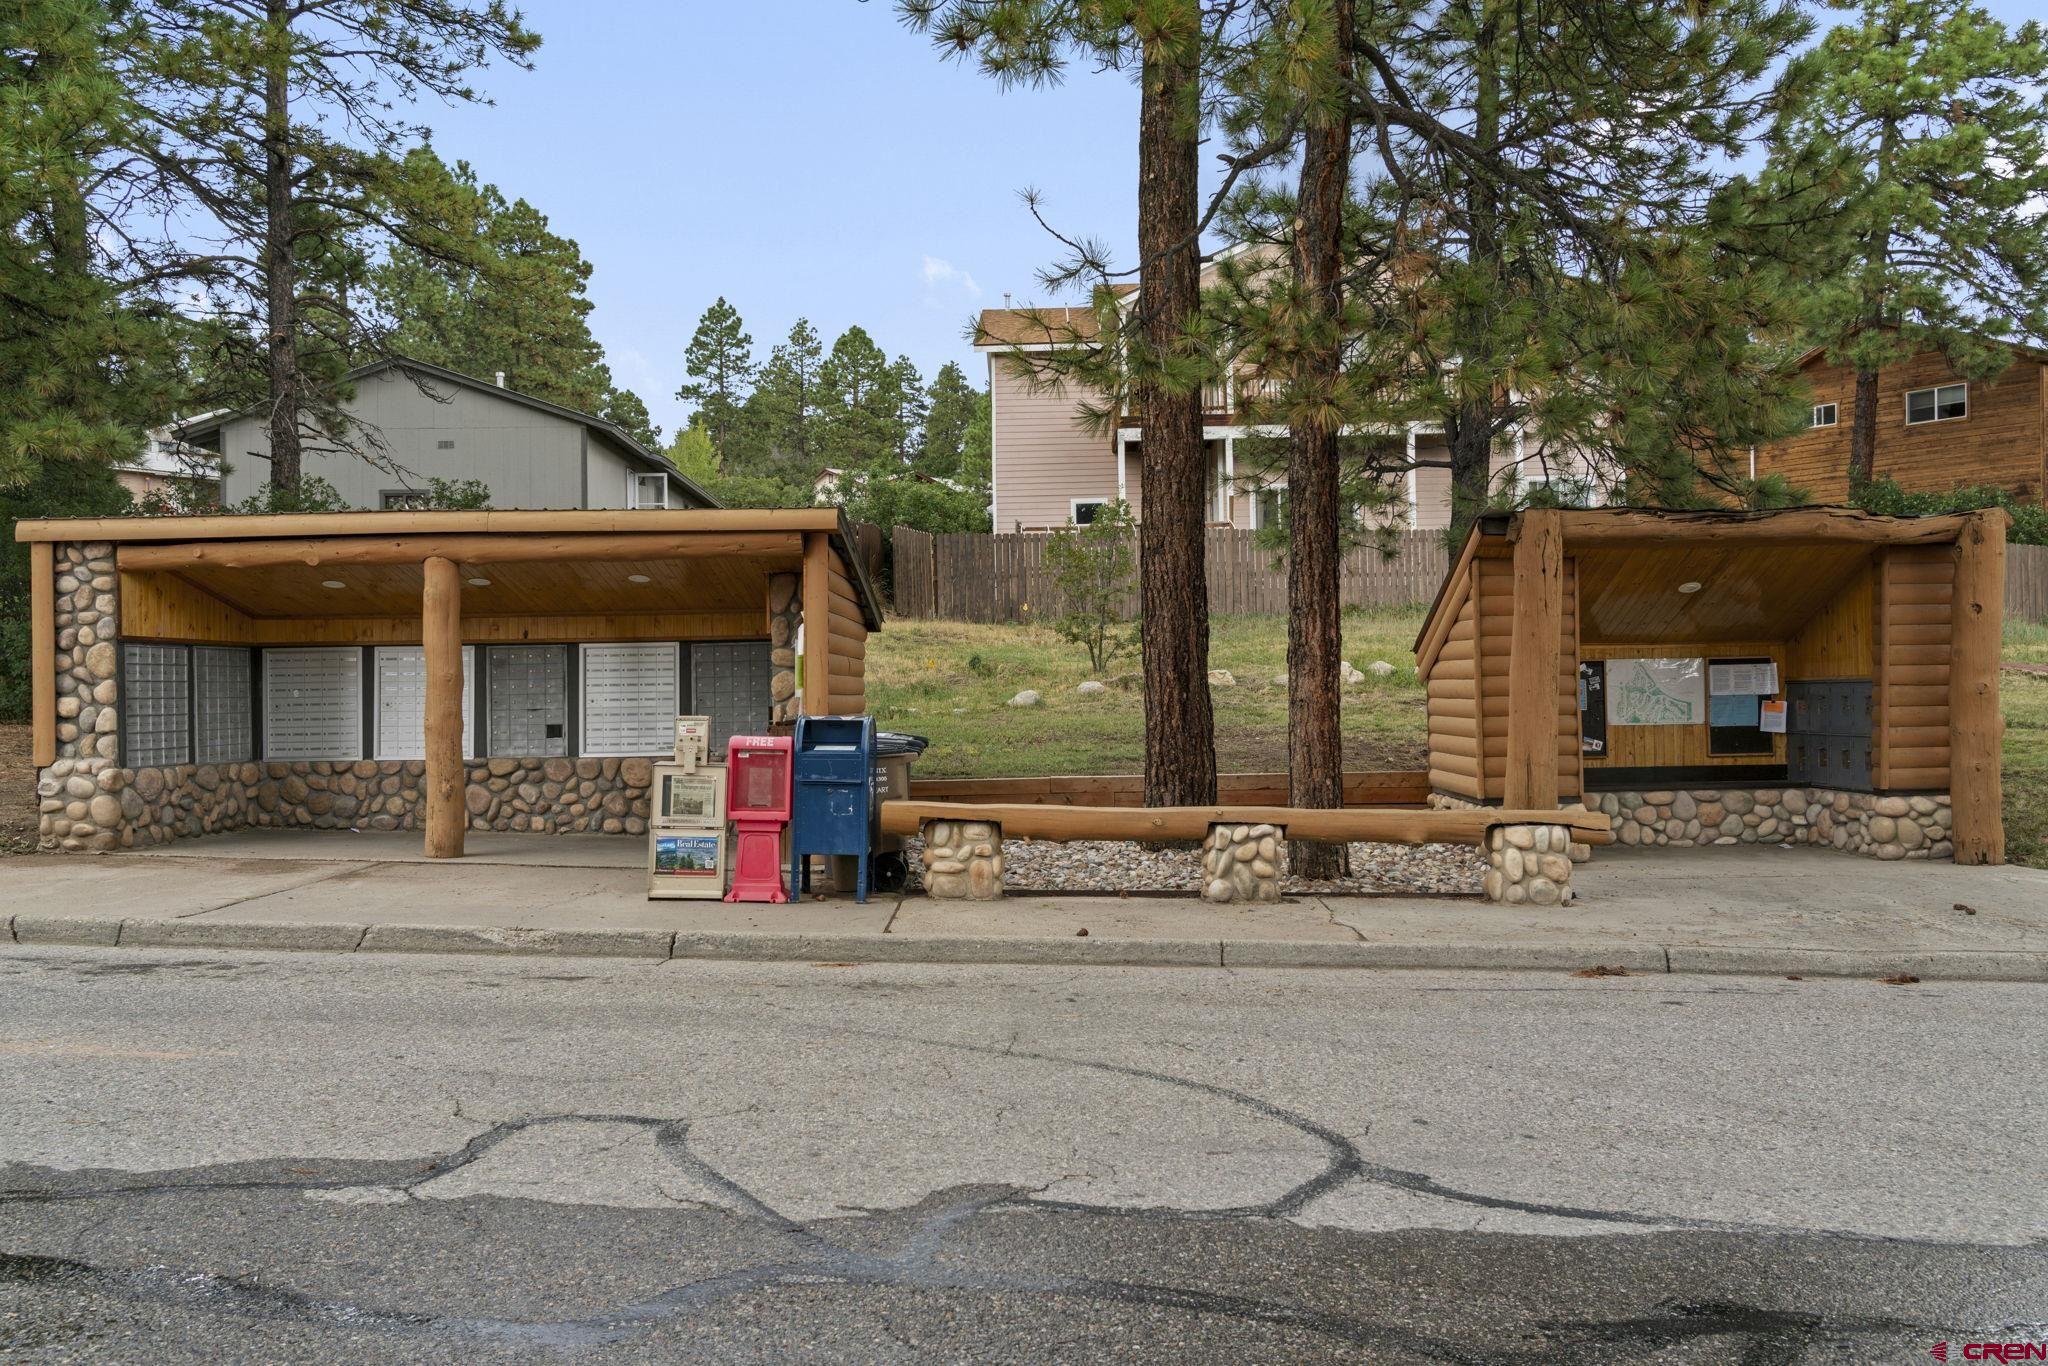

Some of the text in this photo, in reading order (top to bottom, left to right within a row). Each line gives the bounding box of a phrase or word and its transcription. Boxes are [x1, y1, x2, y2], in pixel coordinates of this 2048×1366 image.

[746, 736, 775, 747] FREE
[677, 839, 693, 848] Real
[693, 839, 716, 849] Estate
